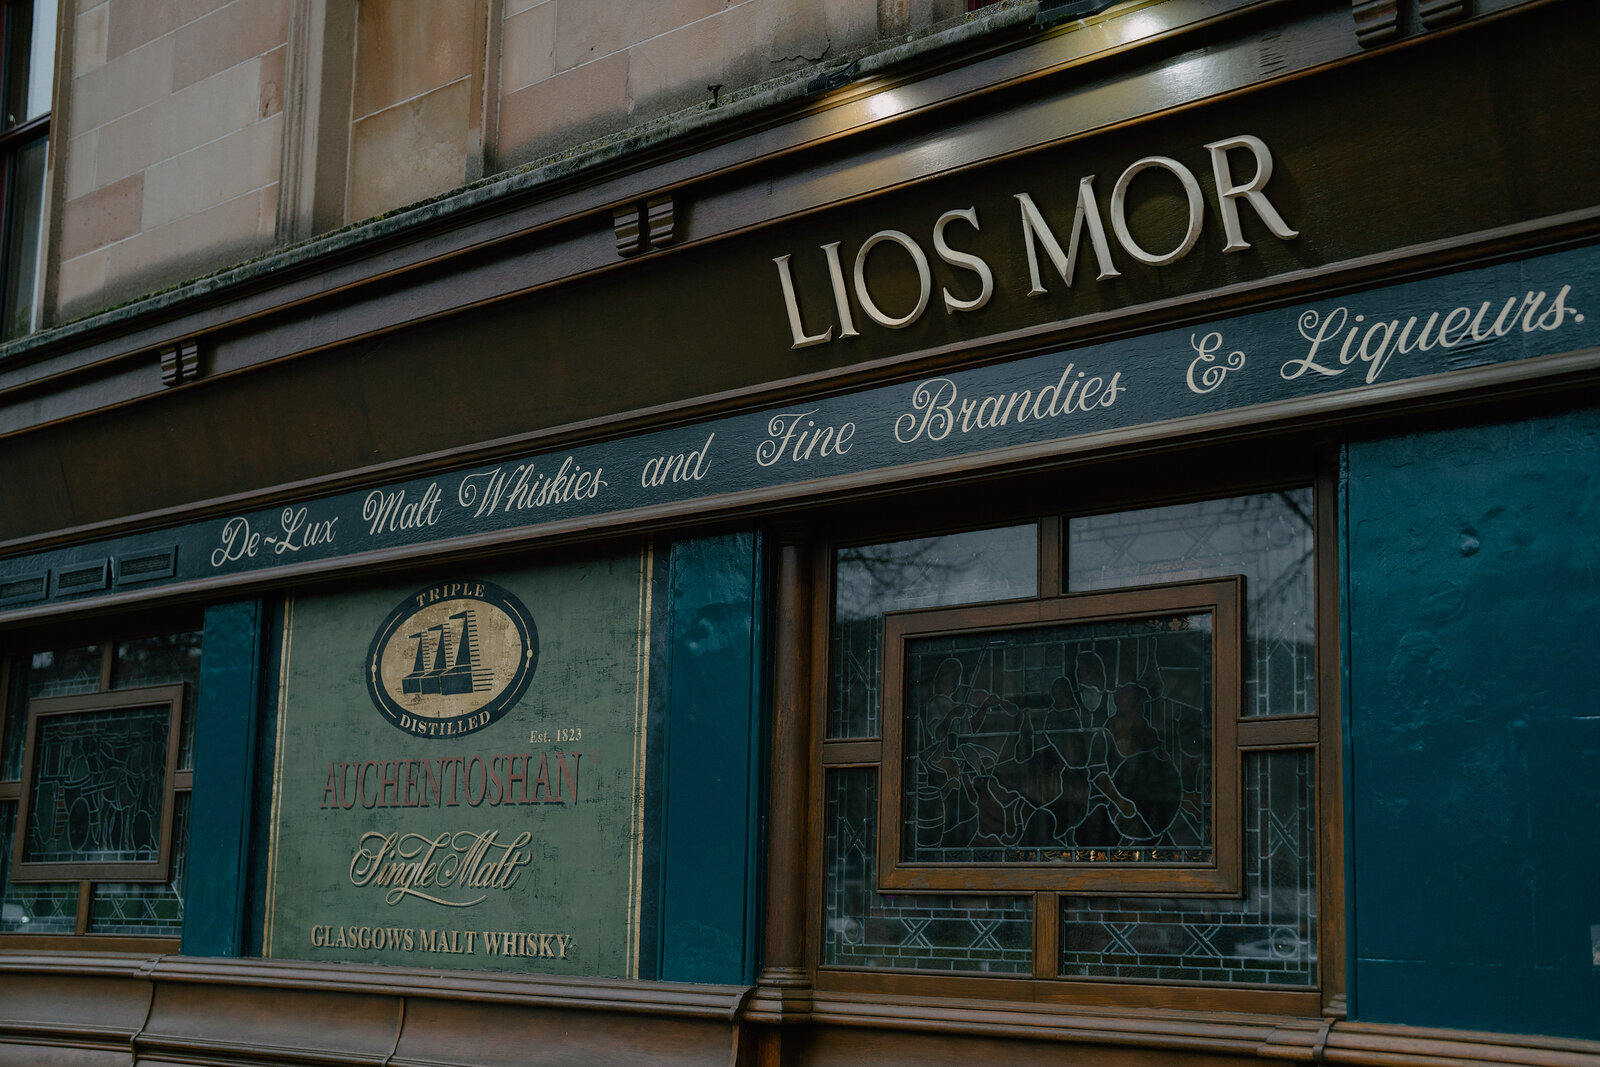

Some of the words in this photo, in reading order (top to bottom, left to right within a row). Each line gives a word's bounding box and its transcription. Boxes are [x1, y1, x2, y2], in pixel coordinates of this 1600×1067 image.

[773, 206, 993, 349] LIOS
[1013, 134, 1299, 297] MOR
[362, 482, 442, 536] Malt
[458, 456, 608, 518] Whiskies
[641, 432, 715, 488] and
[756, 408, 856, 467] Fine
[895, 363, 1126, 443] Brandies
[1186, 332, 1246, 394] &
[1280, 284, 1585, 384] Liqueurs.
[416, 583, 486, 607] TRIPLE
[400, 710, 491, 736] DISTILLED
[530, 730, 551, 744] Est.
[556, 728, 582, 742] 1823
[320, 750, 582, 810] AUCHENTOSHAN
[350, 831, 487, 906] Single
[435, 829, 532, 889] Malt
[310, 924, 415, 952] GLASGOWS
[419, 928, 479, 955] MALT
[482, 931, 572, 960] WHISKY
